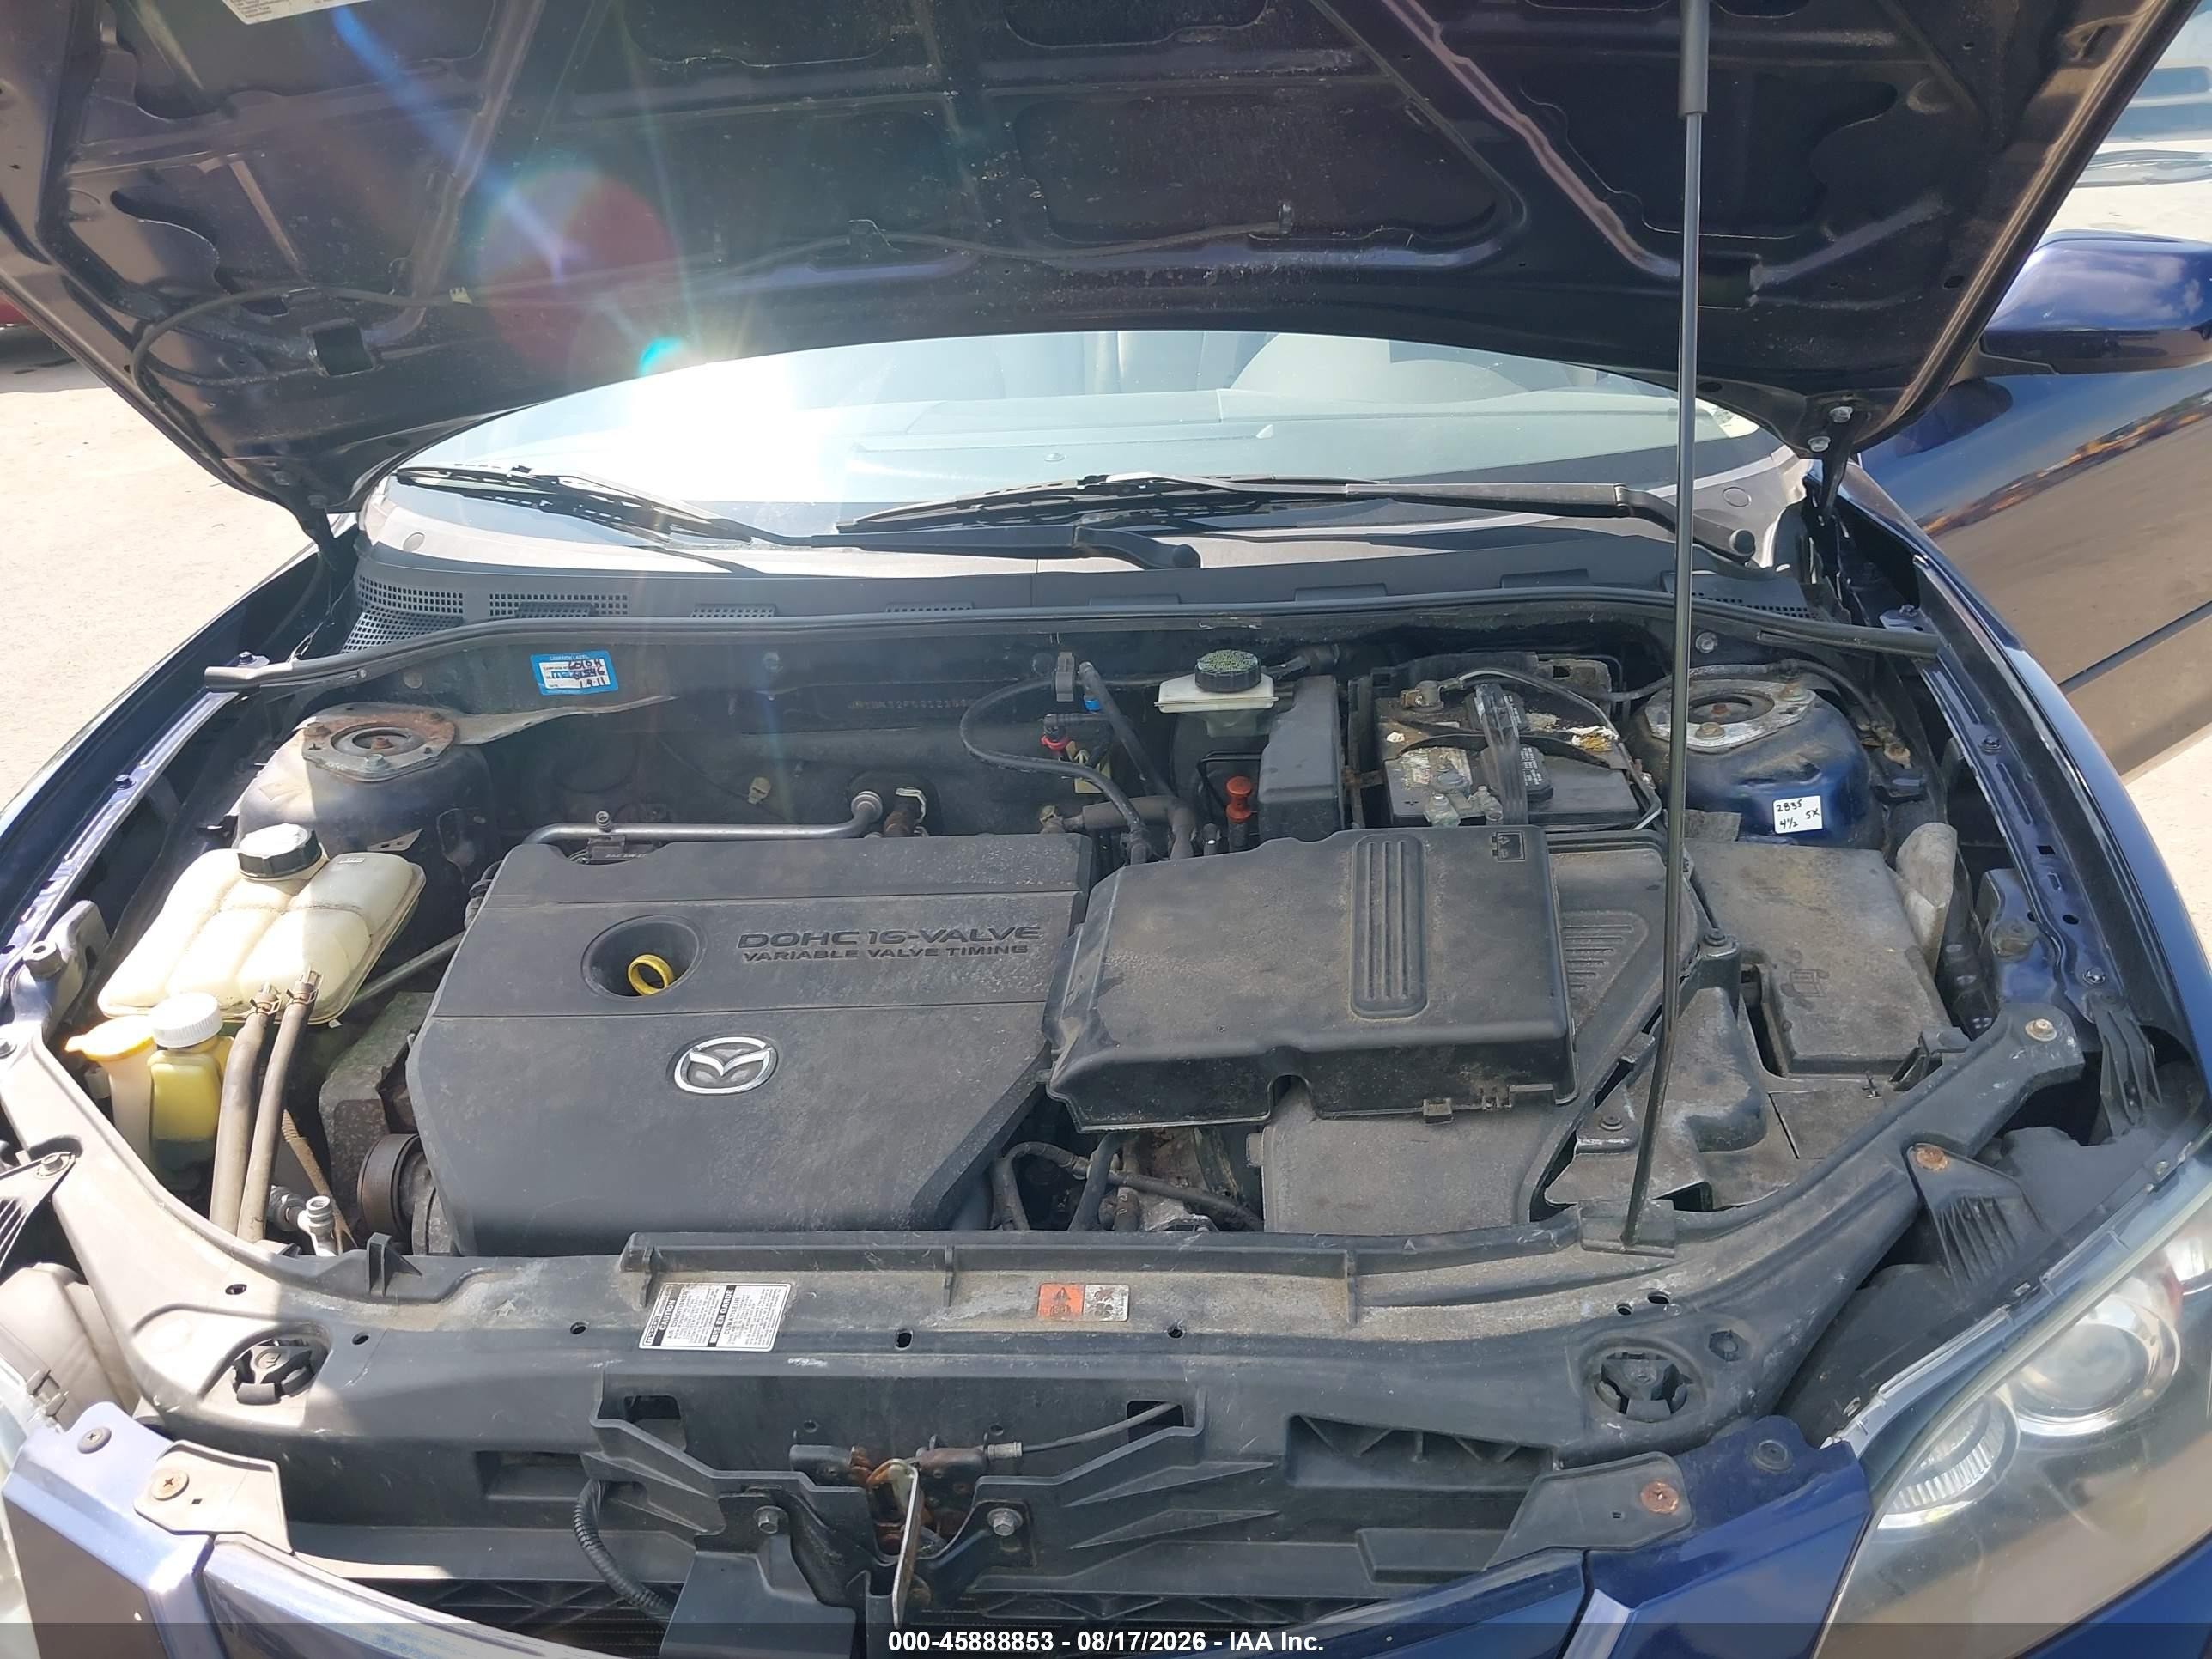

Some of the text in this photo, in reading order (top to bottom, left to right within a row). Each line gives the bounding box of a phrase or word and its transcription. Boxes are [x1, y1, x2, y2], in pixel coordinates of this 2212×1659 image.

[1776, 799, 1802, 812] 2835
[738, 926, 1041, 949] DOHC 16-VALVE
[744, 945, 1028, 962] VARIABLE VALVE TIMING
[719, 1289, 734, 1313] GARDE
[659, 1299, 676, 1330] CAUTION
[724, 1297, 740, 1334] CLIMATISEUR
